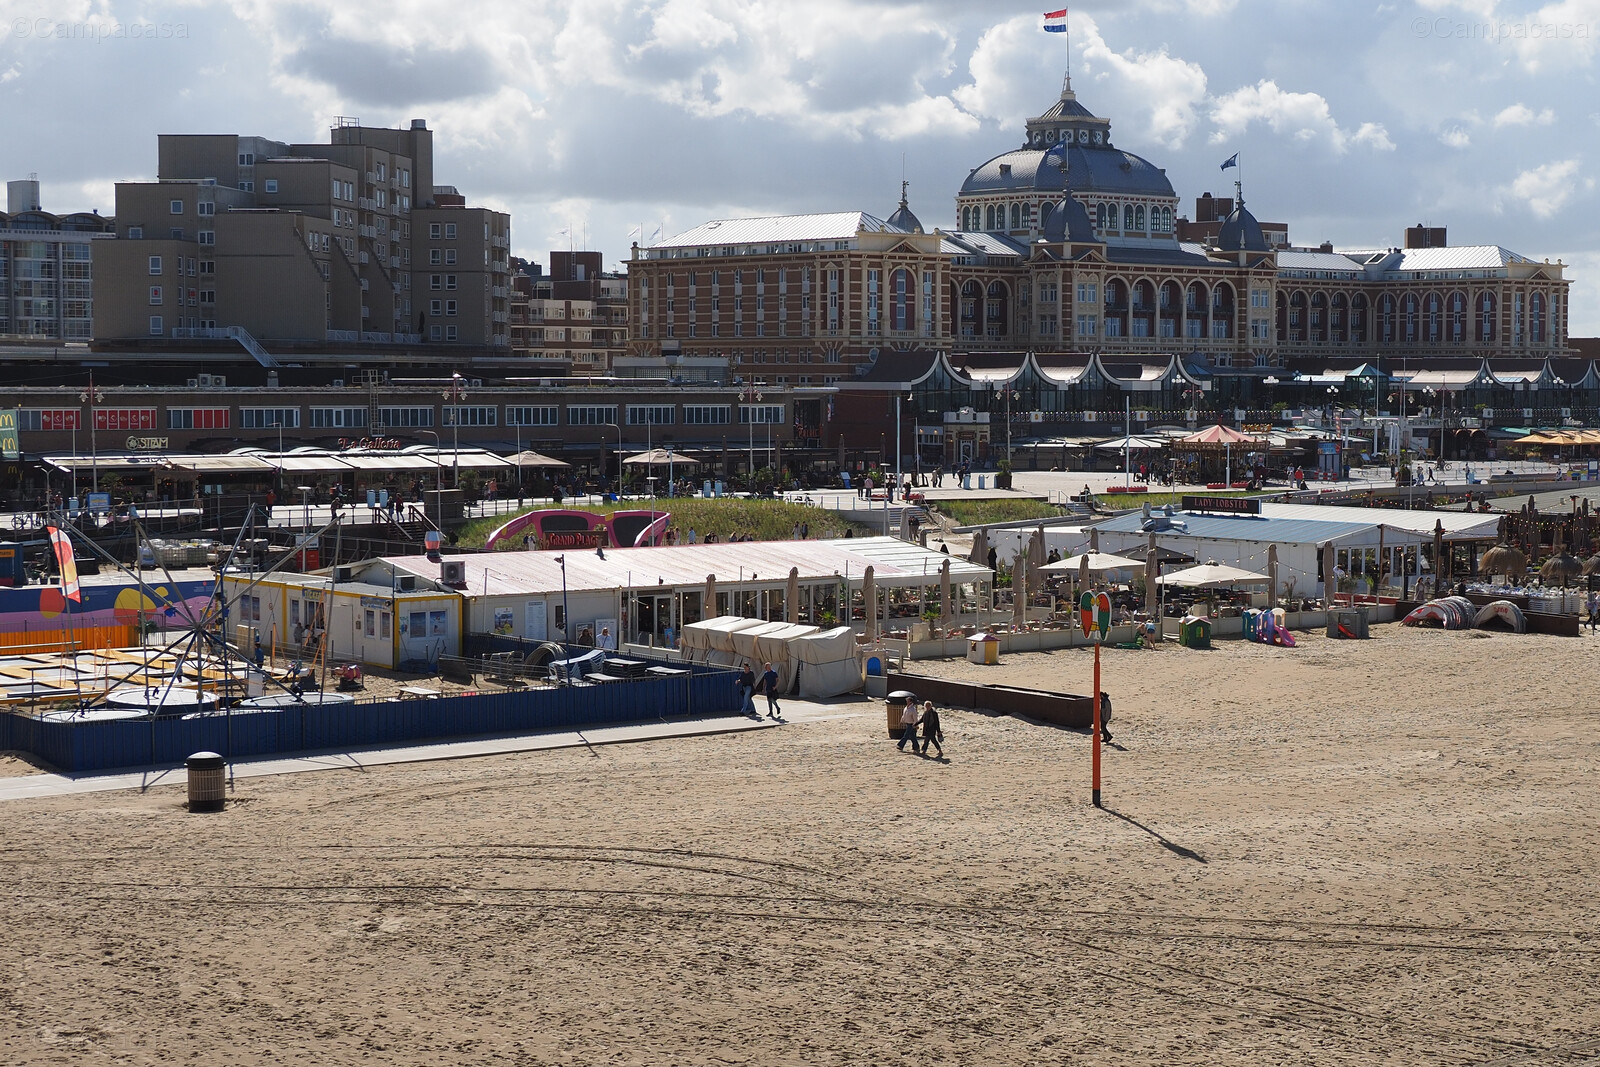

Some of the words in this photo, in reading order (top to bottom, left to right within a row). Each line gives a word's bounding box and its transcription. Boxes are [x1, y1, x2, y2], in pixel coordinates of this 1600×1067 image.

[338, 437, 358, 450] La
[360, 436, 402, 450] Galleria
[1194, 498, 1213, 507] LADY
[1215, 499, 1248, 509] LOBSTER
[549, 533, 575, 546] GRAND
